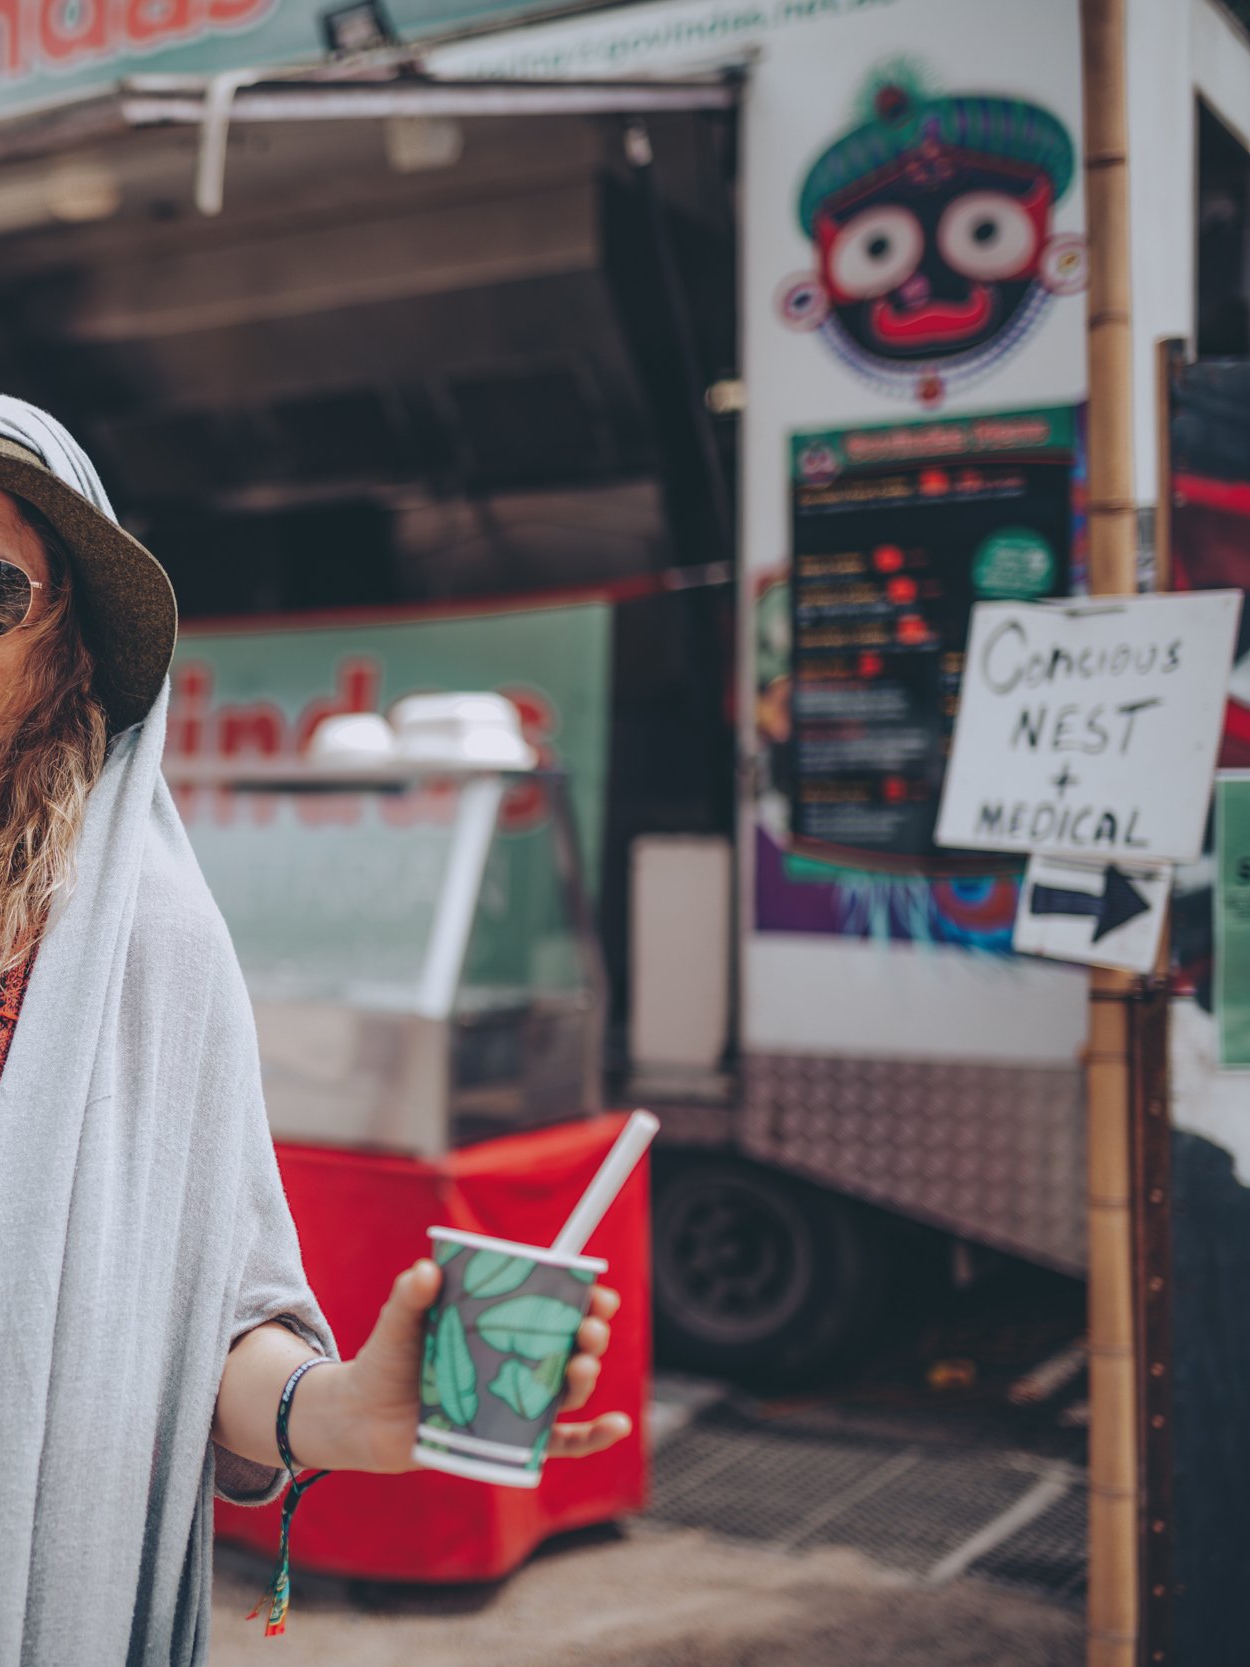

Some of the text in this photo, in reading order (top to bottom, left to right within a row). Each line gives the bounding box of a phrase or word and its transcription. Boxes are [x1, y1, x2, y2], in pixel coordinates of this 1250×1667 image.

[982, 619, 1184, 695] Concious
[1011, 698, 1162, 757] NEST
[974, 801, 1149, 848] MEDICAL
